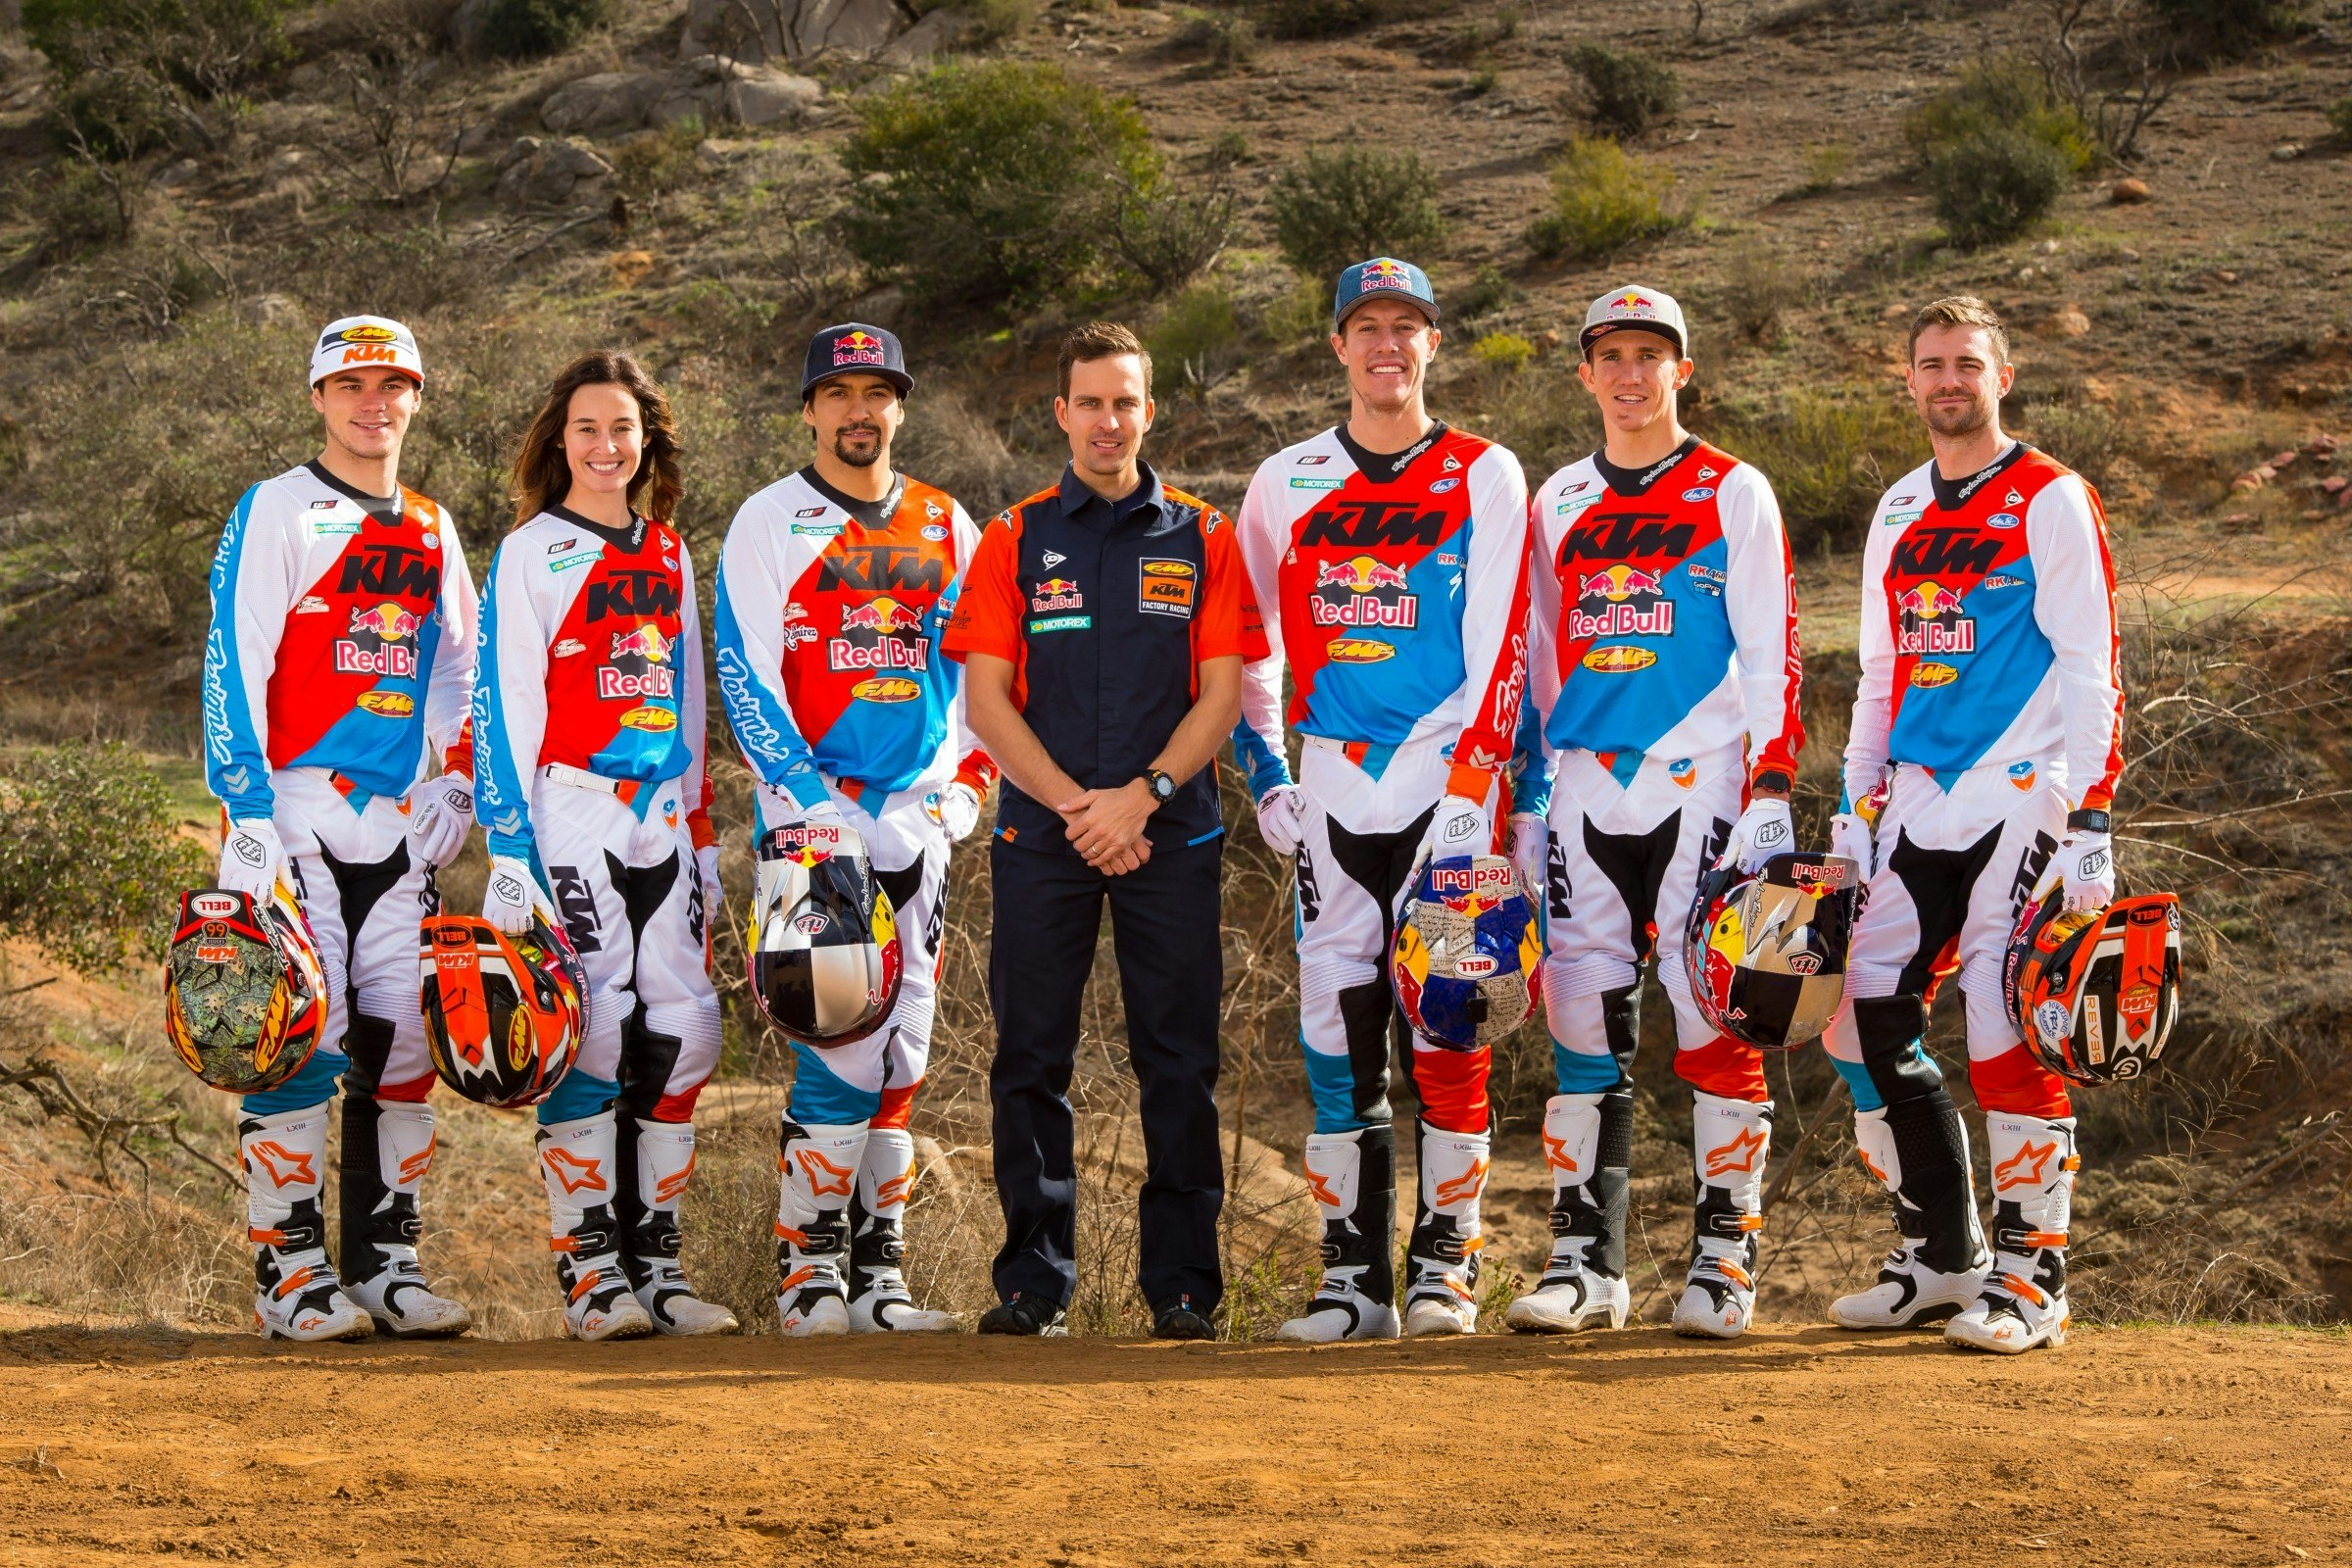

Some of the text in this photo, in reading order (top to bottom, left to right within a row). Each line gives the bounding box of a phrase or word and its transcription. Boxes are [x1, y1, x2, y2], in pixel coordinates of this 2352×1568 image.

[1361, 276, 1411, 292] Red Bull
[343, 326, 397, 340] FMF
[342, 344, 397, 364] KTM
[834, 349, 884, 367] Red Bull
[1303, 479, 1342, 488] MOTOREX
[1569, 496, 1600, 511] MOTOREX
[324, 523, 361, 533] MOTOREX
[804, 526, 842, 535] MOTOREX
[1298, 501, 1447, 547] KTM
[1561, 513, 1697, 566] KTM
[564, 552, 602, 568] MOTOREX
[1439, 553, 1457, 564] RK
[1890, 527, 2004, 580] KTM
[336, 544, 442, 602] KTM
[815, 546, 943, 593] KTM
[1145, 563, 1194, 575] FMF
[1689, 564, 1707, 577] RK
[1150, 582, 1186, 599] KTM
[1985, 575, 2006, 589] RK
[586, 569, 681, 623] KTM
[1032, 594, 1083, 612] Red Bull
[1142, 601, 1190, 615] FACTORY RACING
[1310, 594, 1417, 627] Red Bull
[1043, 618, 1088, 629] MOTOREX
[1569, 602, 1673, 640] Red Bull
[1897, 619, 1975, 655] Red Bull
[336, 640, 417, 679] Red Bu
[830, 636, 928, 671] Red Bull
[1326, 639, 1396, 661] FMF
[1582, 647, 1658, 668] FMF
[599, 664, 655, 699] Red
[1910, 665, 1959, 685] FMF
[852, 680, 922, 700] FMF
[358, 692, 415, 713] FMF
[620, 709, 678, 729] FMF
[776, 827, 839, 849] Red Bull
[1432, 869, 1472, 891] Bull
[1472, 866, 1512, 890] Red
[1791, 861, 1845, 882] Red Bull
[199, 901, 232, 911] BELL
[549, 865, 602, 954] KTM
[2134, 908, 2162, 922] BELL
[205, 923, 226, 938] 66
[437, 926, 467, 942] BELL
[195, 945, 239, 964] KTM
[437, 953, 474, 969] KTM
[1459, 959, 1493, 972] BELL
[2122, 993, 2159, 1014] KTM
[512, 1009, 533, 1069] FMF
